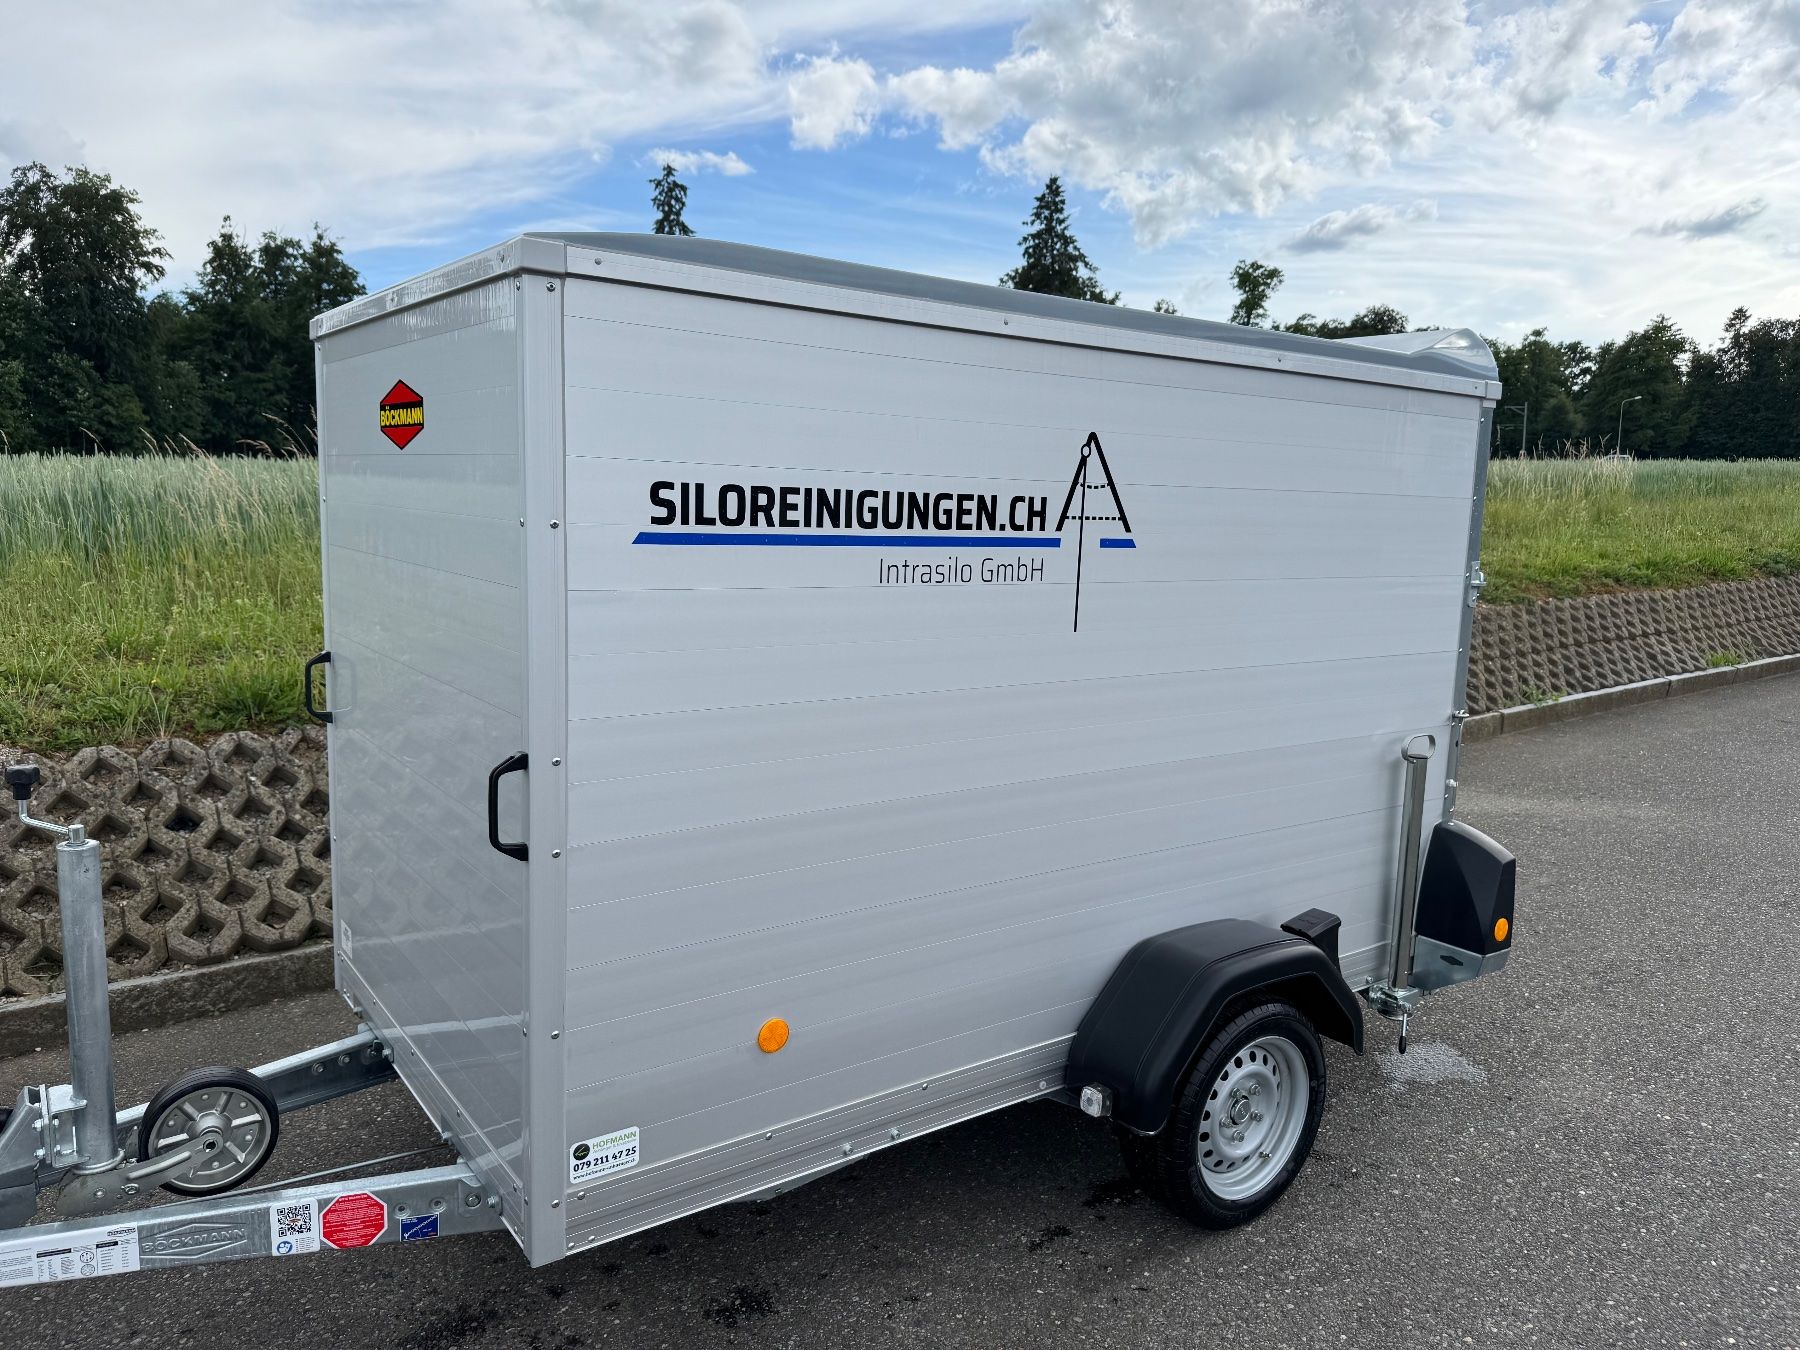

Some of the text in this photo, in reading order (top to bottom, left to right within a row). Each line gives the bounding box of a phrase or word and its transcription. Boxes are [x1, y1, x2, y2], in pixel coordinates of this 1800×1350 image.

[380, 405, 423, 426] BÖCKMANN
[649, 480, 1048, 532] SILOREINIGUNGEN.CH
[879, 556, 1044, 584] Intrasilo GmbH
[592, 1131, 637, 1149] HOFMANN
[573, 1160, 591, 1173] 079
[593, 1155, 609, 1167] 211
[612, 1150, 623, 1161] 47
[625, 1146, 637, 1157] 25
[141, 1228, 246, 1252] BÖCKMANN
